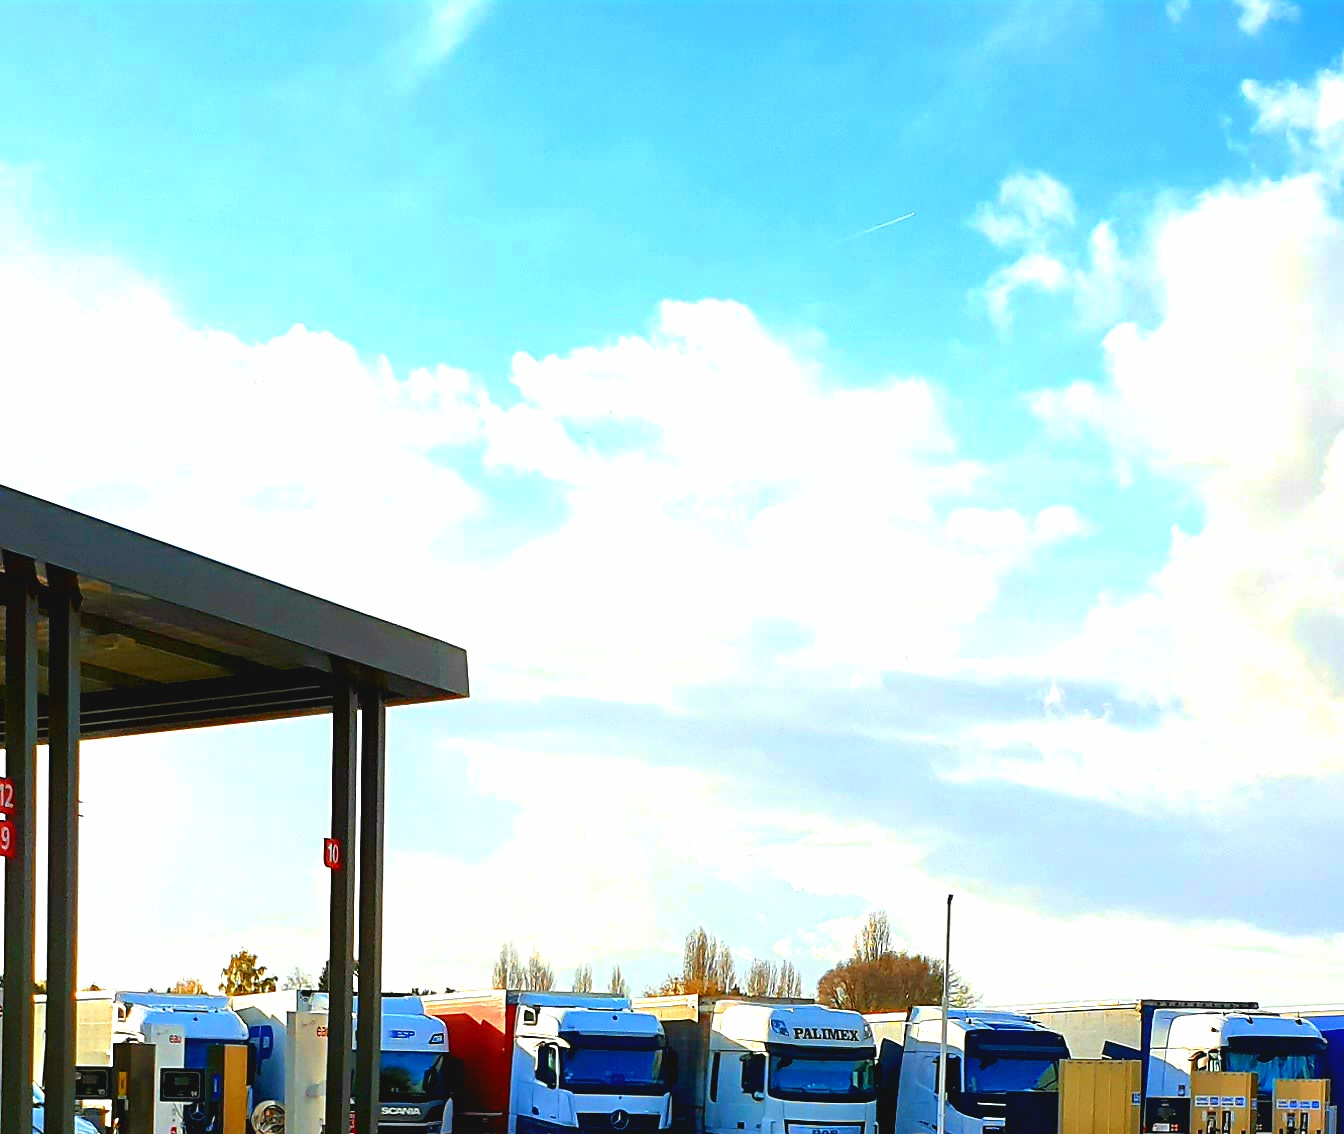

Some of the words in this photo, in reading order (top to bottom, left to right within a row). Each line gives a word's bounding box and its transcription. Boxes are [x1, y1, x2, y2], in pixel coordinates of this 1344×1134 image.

[1, 826, 11, 850] 9
[328, 842, 339, 864] 10
[793, 1027, 859, 1042] PALIMEX
[381, 1106, 422, 1116] SCANIA
